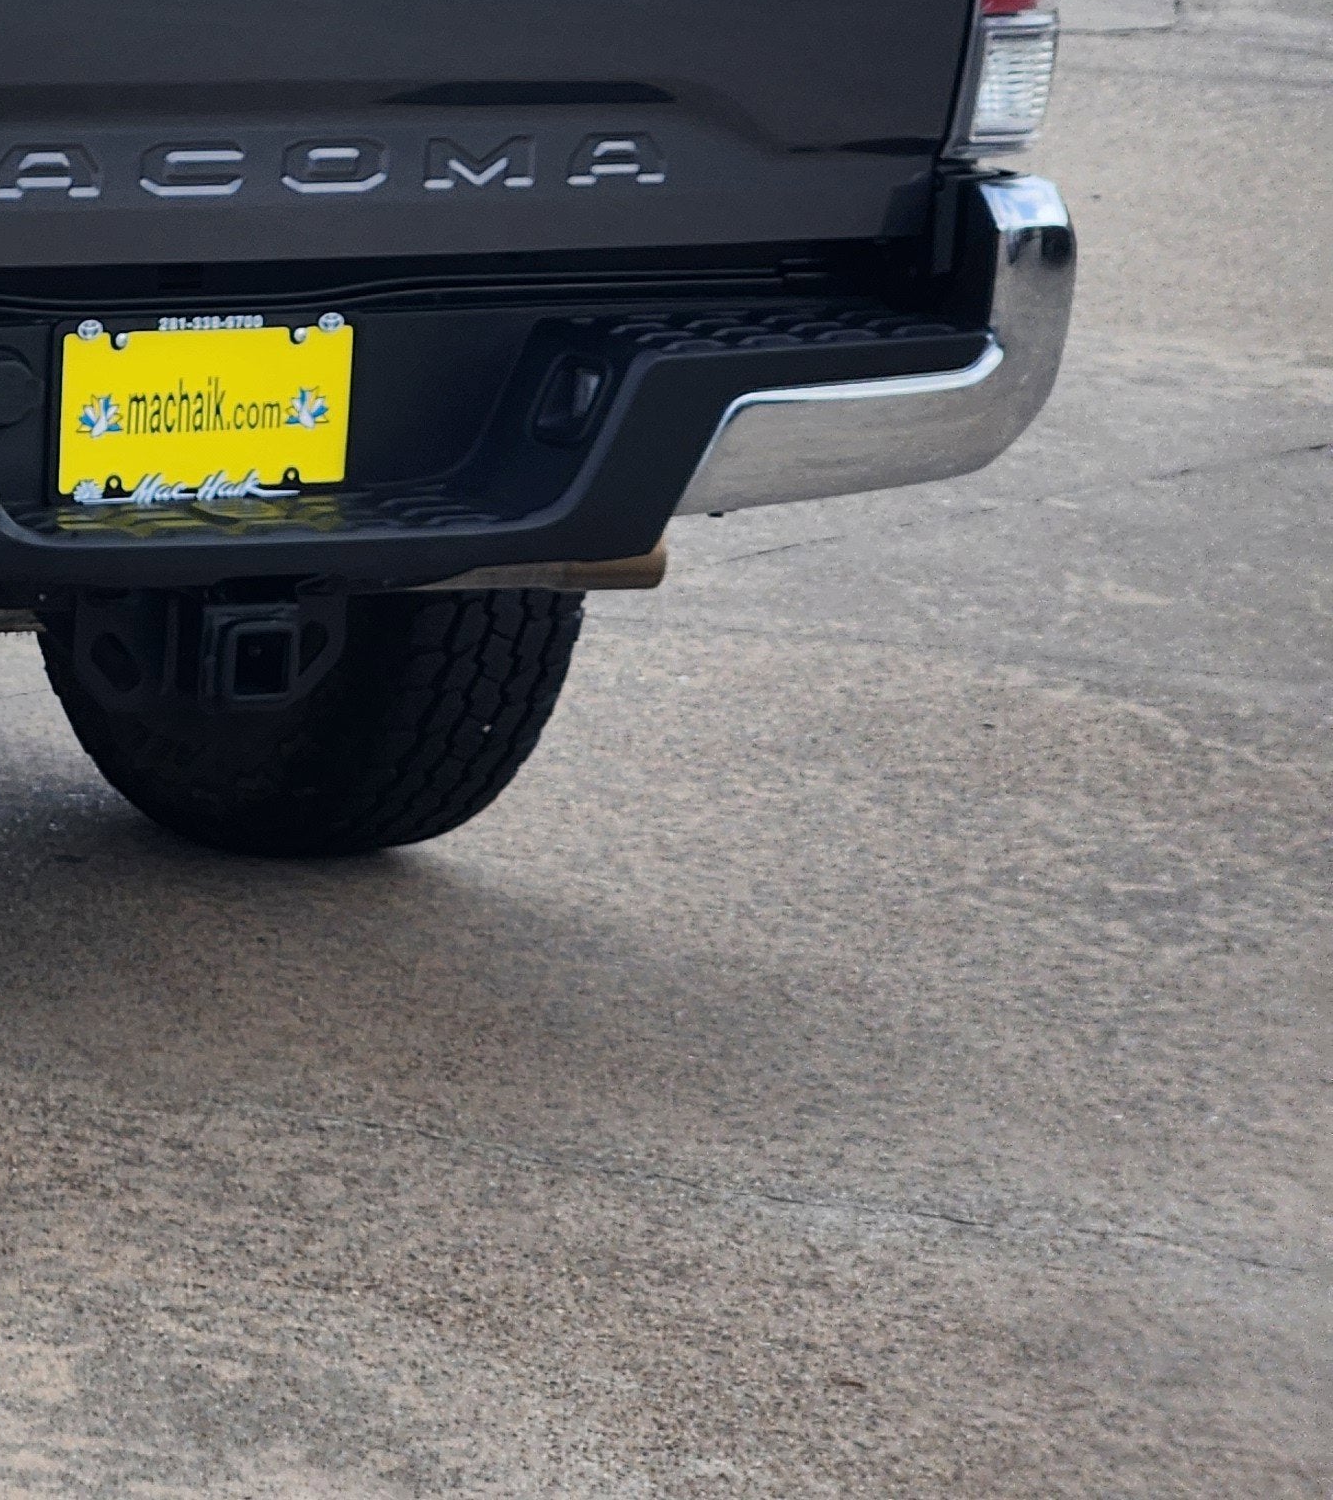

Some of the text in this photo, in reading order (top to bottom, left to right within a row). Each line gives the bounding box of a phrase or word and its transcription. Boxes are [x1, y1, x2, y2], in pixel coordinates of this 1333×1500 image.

[126, 376, 282, 435] machaik.com
[131, 469, 268, 503] Mac Haik
